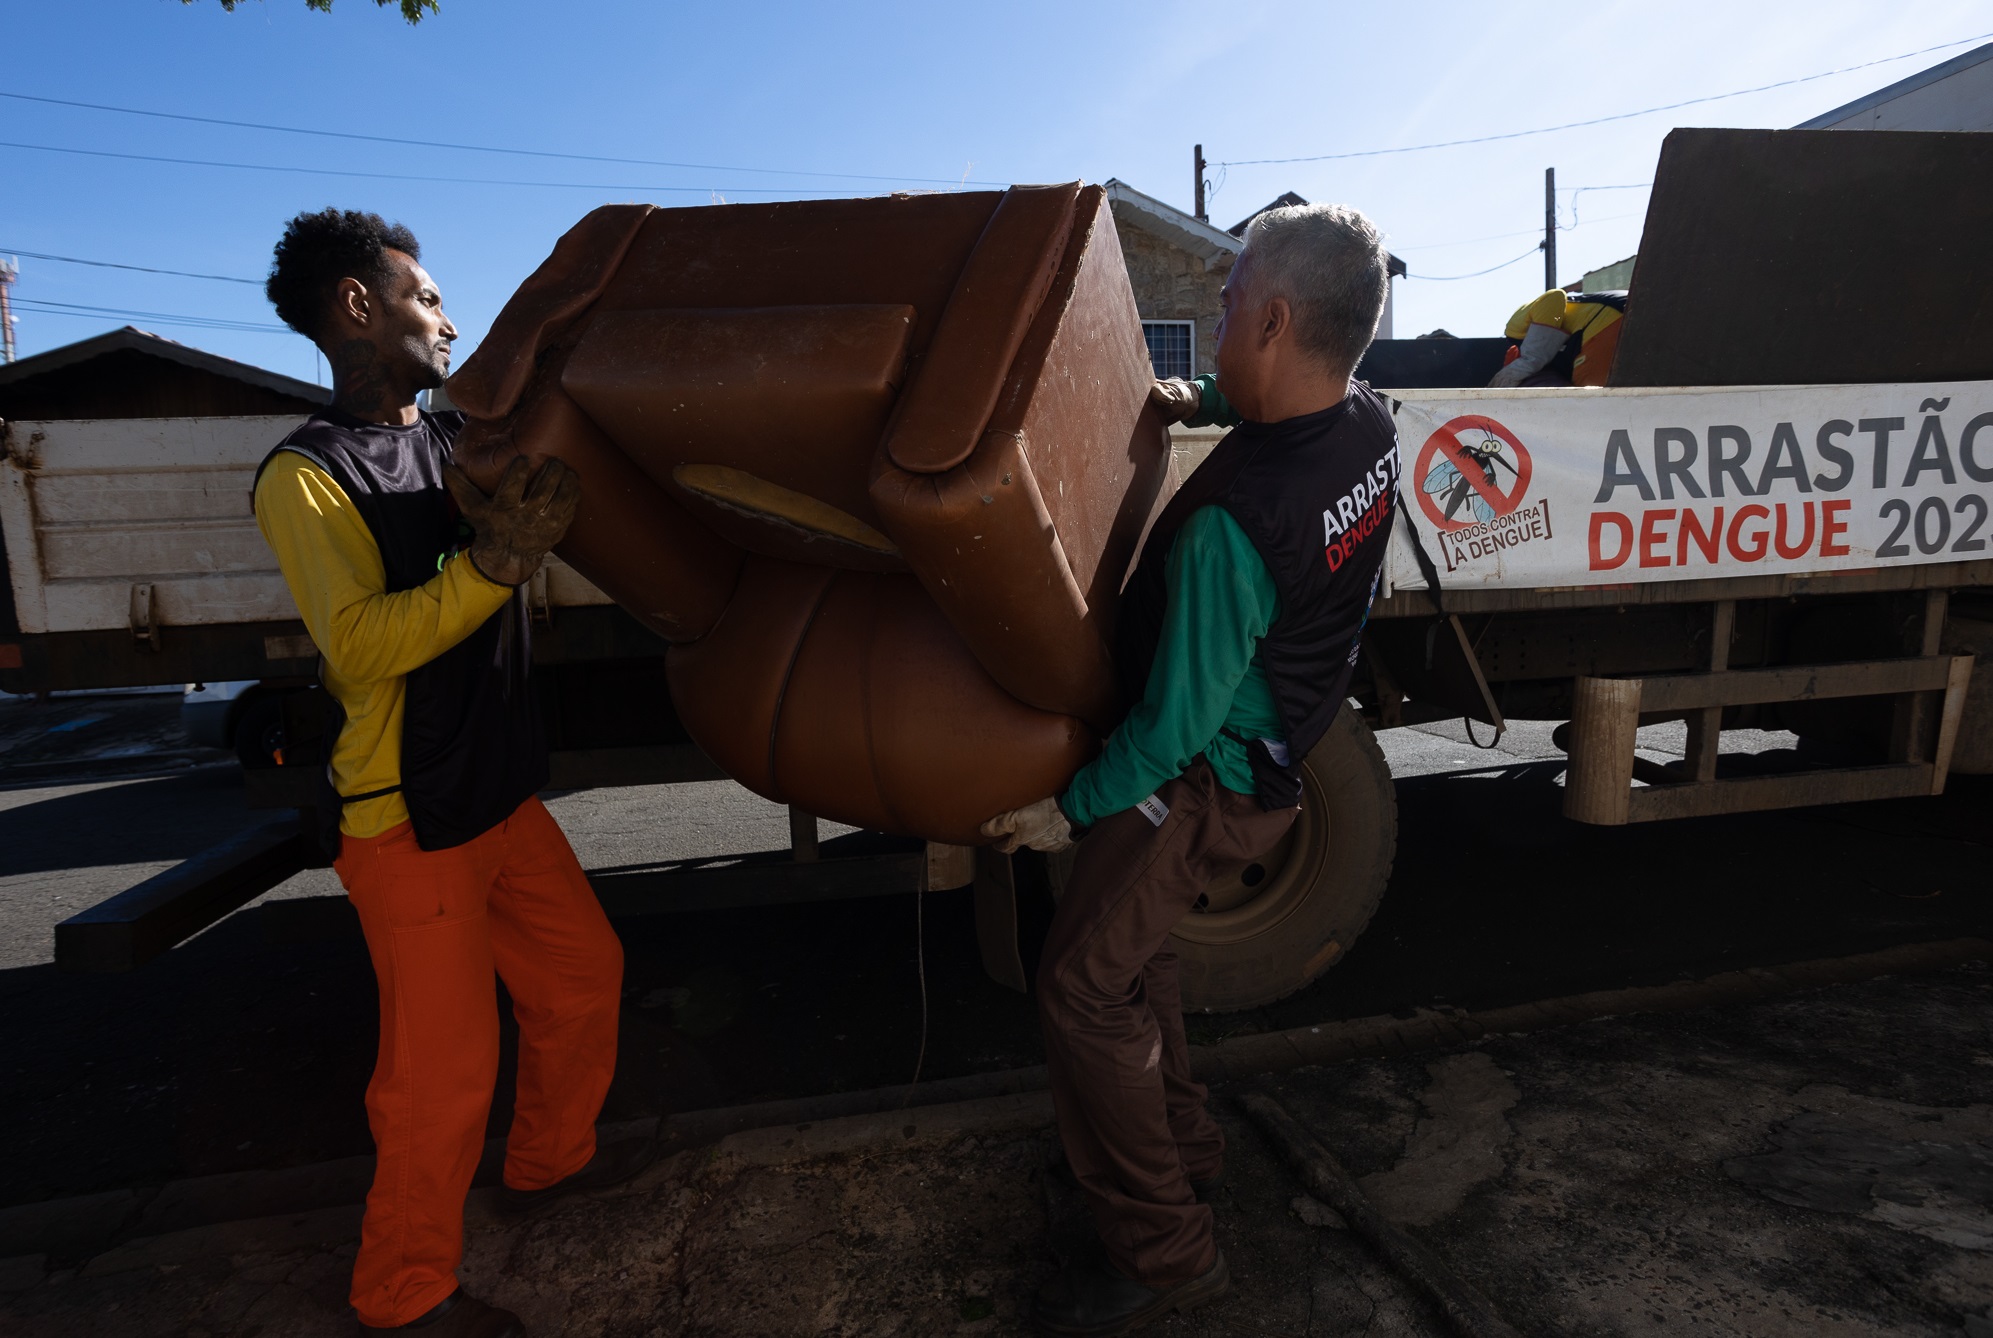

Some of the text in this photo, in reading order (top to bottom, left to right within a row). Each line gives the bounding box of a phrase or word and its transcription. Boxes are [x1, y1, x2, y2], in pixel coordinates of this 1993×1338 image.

[1325, 490, 1389, 573] DENGUE
[1447, 506, 1540, 545] TODOS CONTRA
[1455, 520, 1543, 565] A DENGUE
[1588, 494, 1993, 571] DENGUE 202
